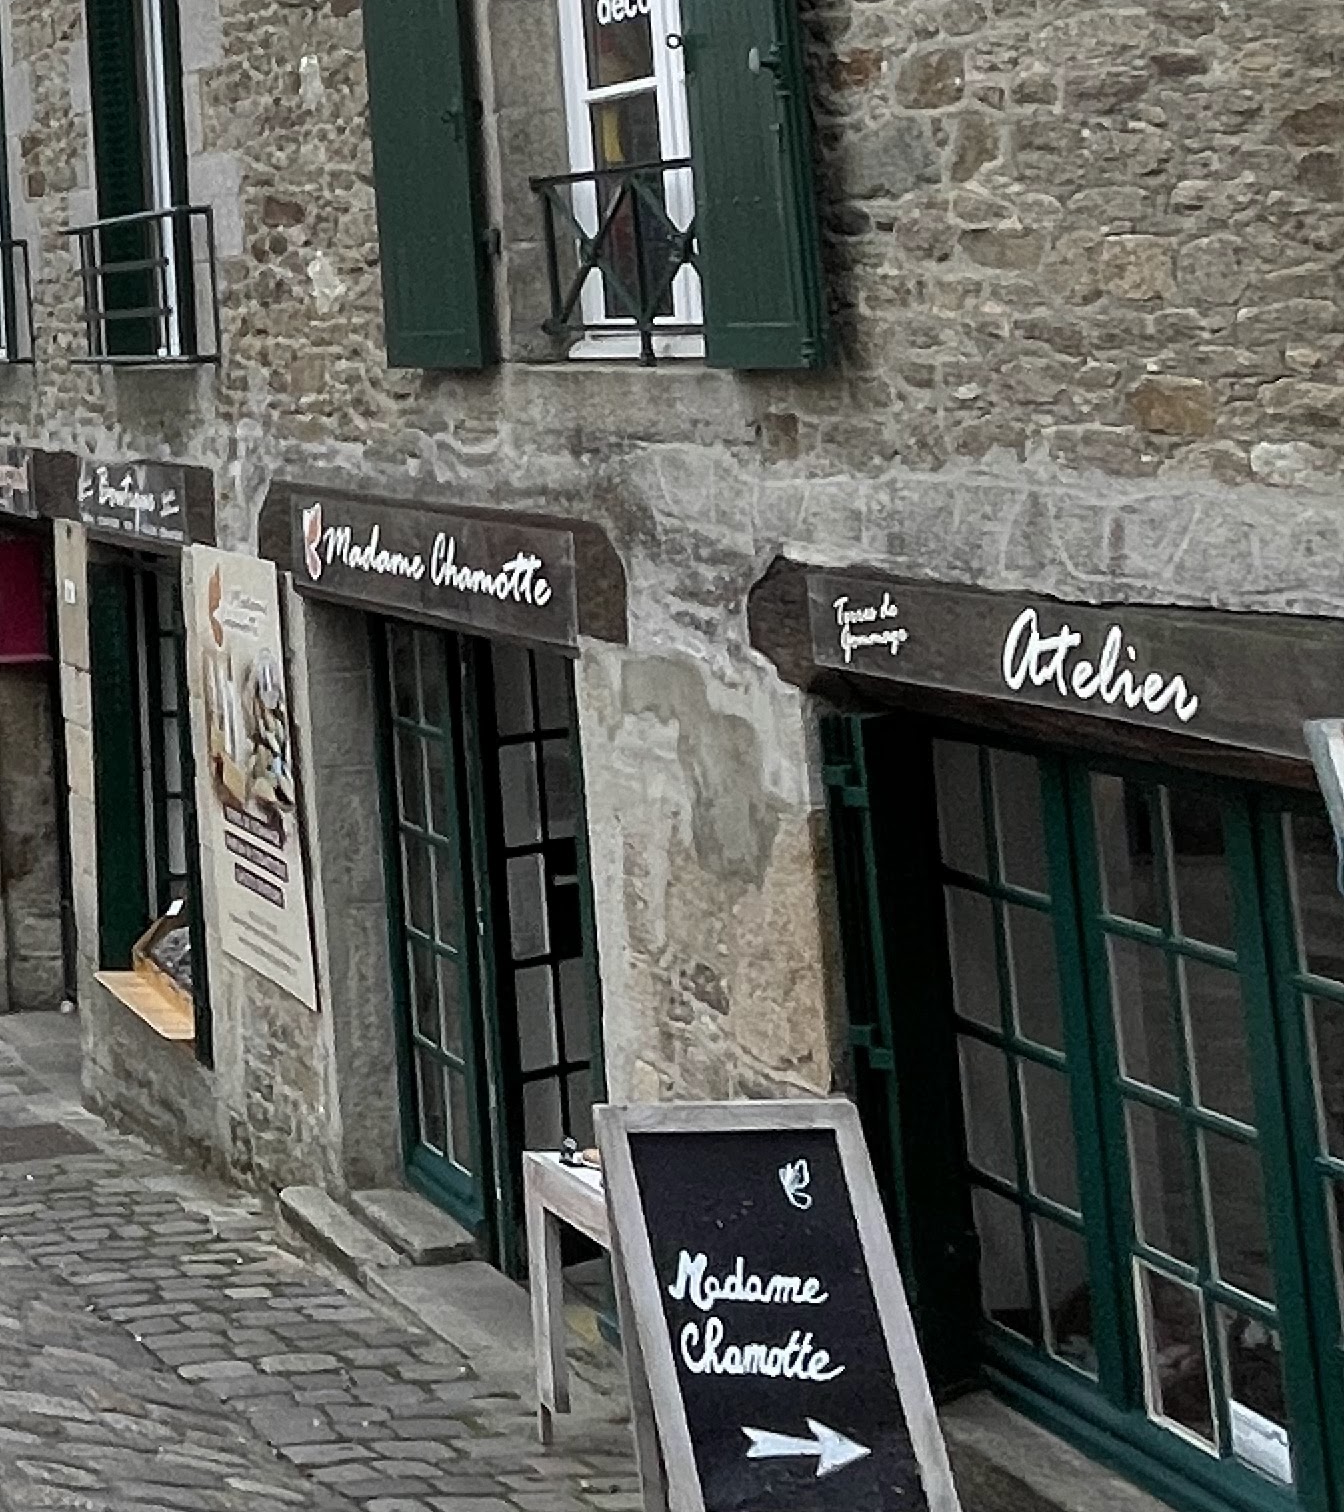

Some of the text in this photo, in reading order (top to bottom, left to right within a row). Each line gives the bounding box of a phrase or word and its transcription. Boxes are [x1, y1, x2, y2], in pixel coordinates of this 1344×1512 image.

[323, 524, 552, 606] Madame Chamotte
[1002, 607, 1199, 723] Atelier
[667, 1249, 830, 1312] Madame
[680, 1316, 846, 1381] Chamotte
